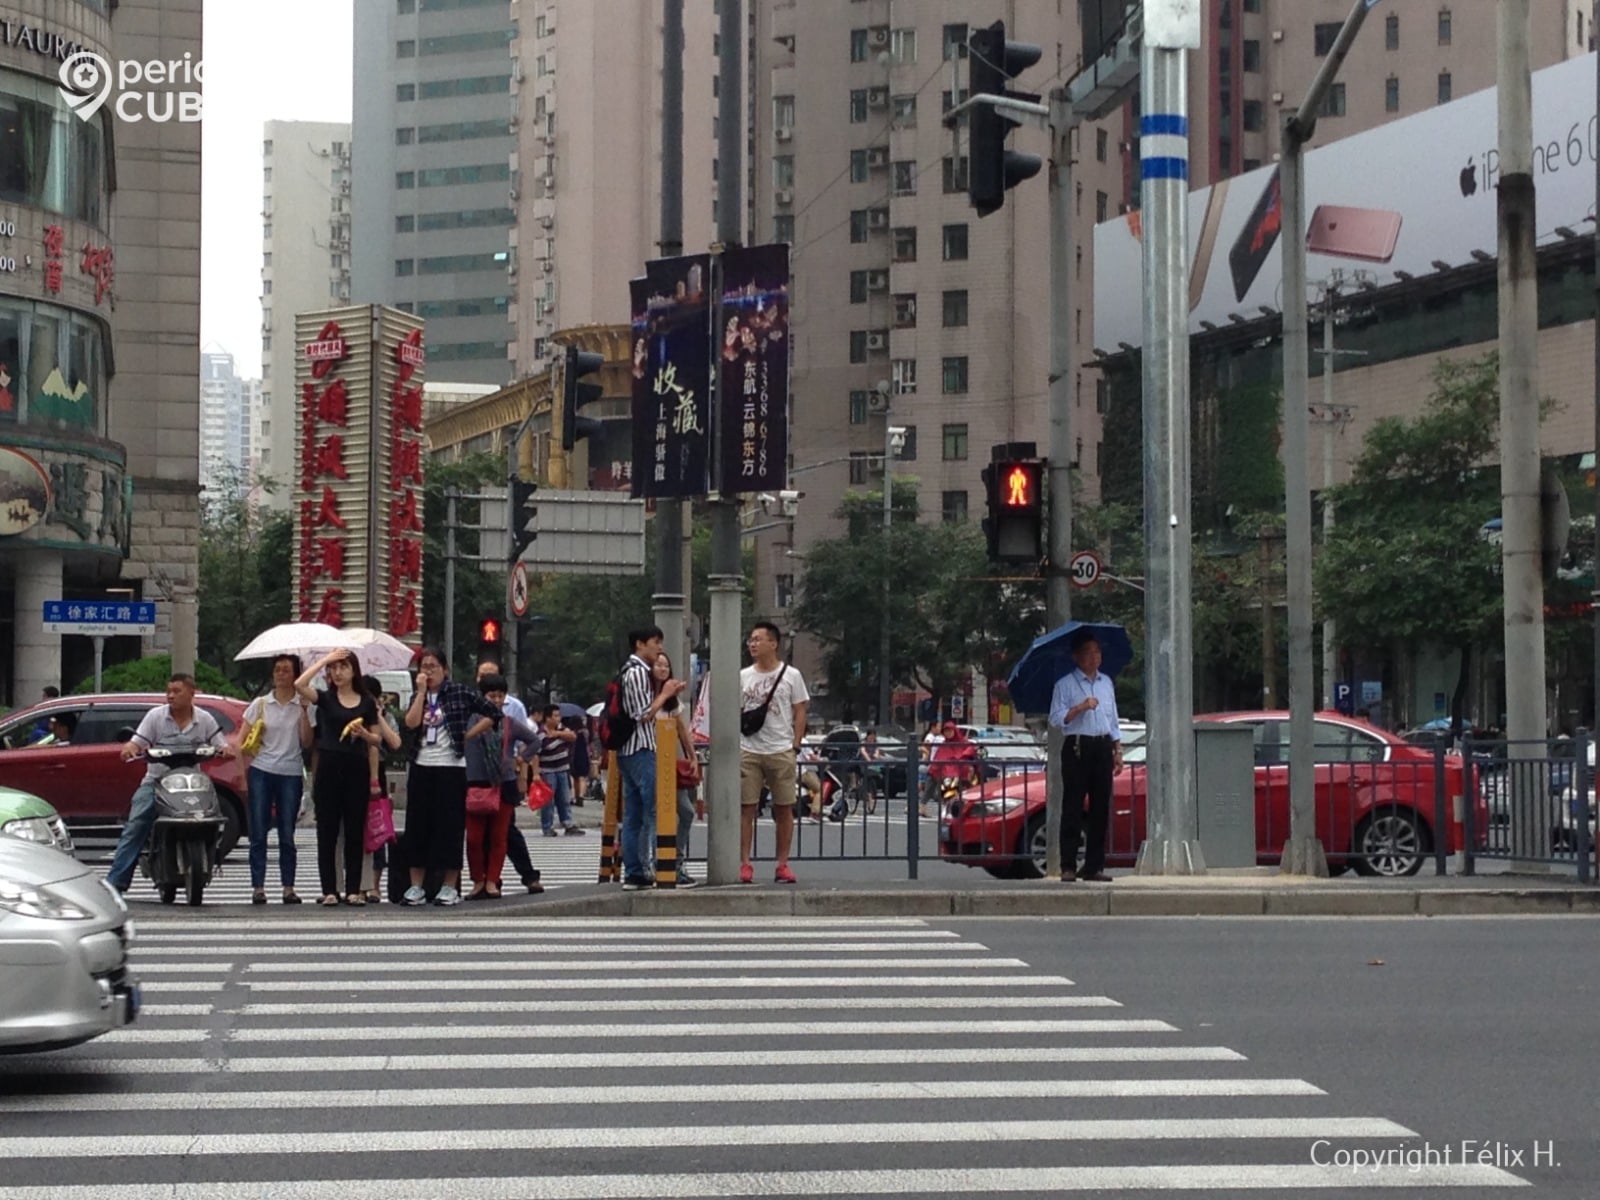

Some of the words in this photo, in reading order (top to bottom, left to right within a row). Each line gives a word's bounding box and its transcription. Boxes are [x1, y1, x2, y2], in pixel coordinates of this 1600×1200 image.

[1481, 141, 1560, 192] iPne
[1076, 561, 1094, 578] 30
[68, 605, 131, 621] 徐家汇路
[138, 625, 148, 633] W
[1338, 684, 1350, 700] P
